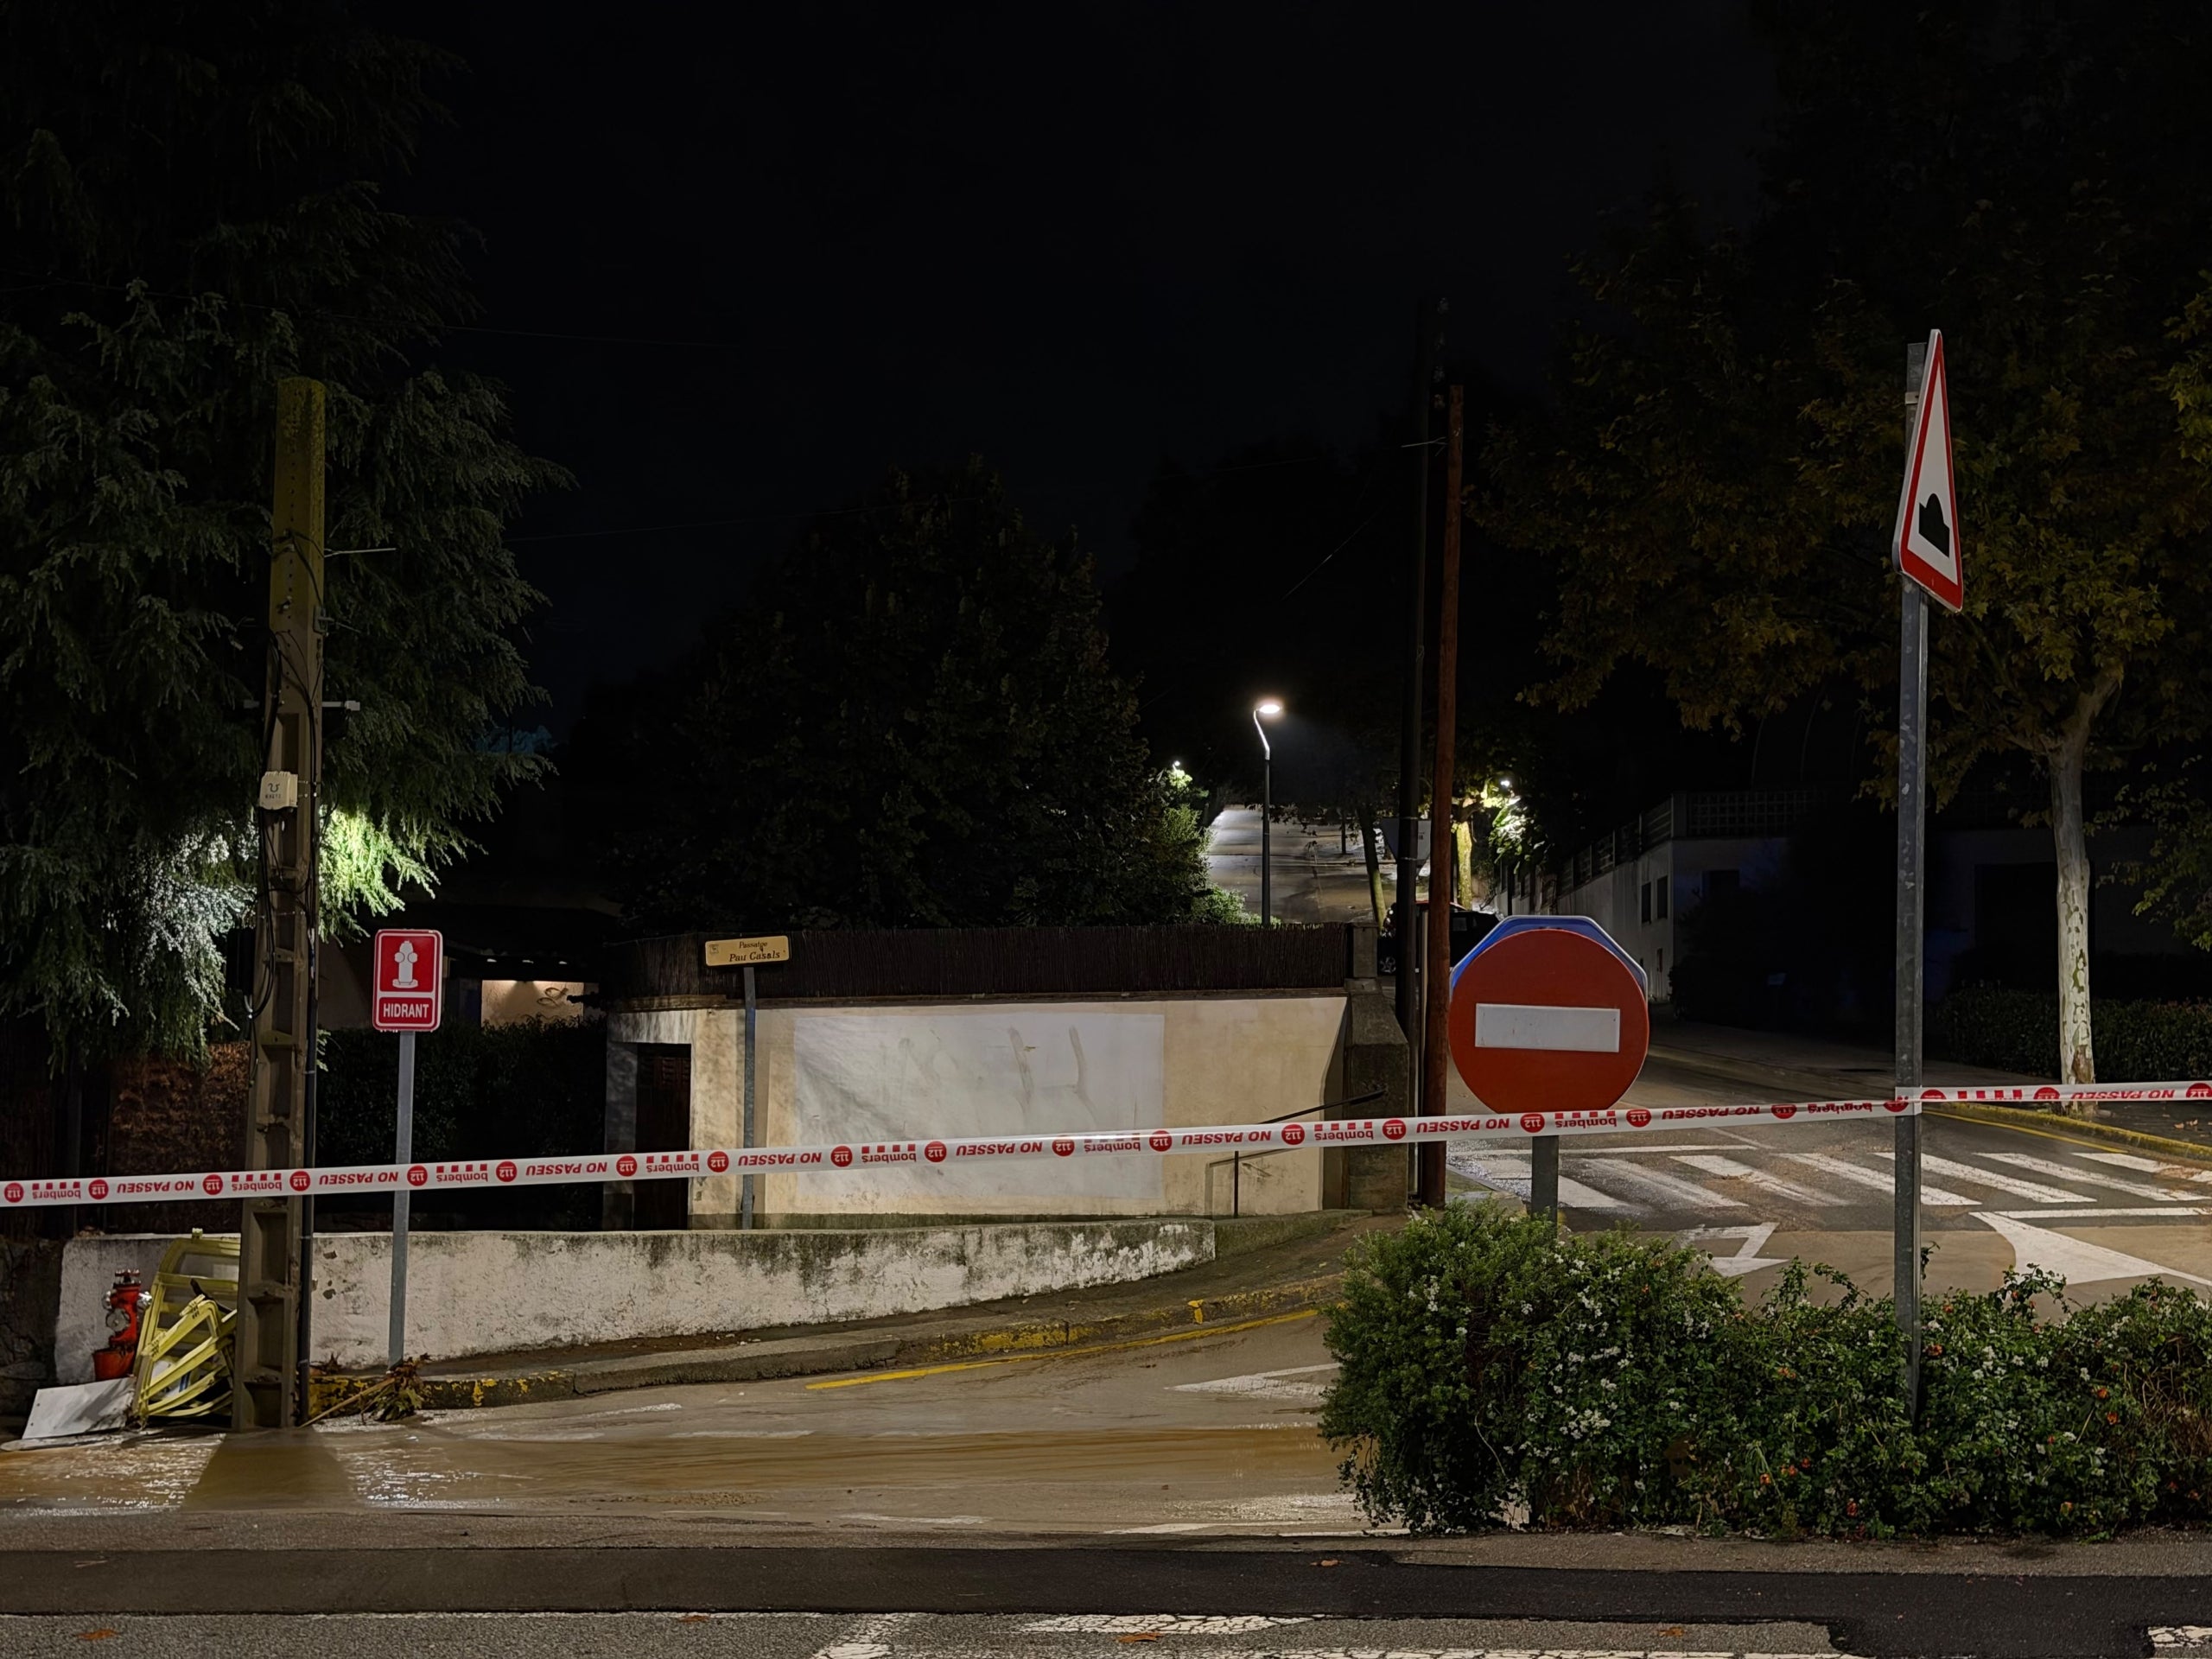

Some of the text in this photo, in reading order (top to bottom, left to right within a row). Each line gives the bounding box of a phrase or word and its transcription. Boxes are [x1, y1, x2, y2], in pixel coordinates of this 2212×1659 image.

[729, 950, 780, 962] Pau Casals
[383, 1003, 429, 1018] HIDRANT
[2148, 1090, 2175, 1098] NO
[1630, 1114, 1648, 1122] 112
[1662, 1106, 1760, 1120] NO PASSEU
[1416, 1119, 1510, 1133] NO PASSEU
[1524, 1119, 1541, 1128] 112
[1554, 1118, 1618, 1128] bombers
[1314, 1130, 1374, 1141] bombers
[1386, 1126, 1403, 1135] 112
[1182, 1131, 1271, 1145] NO PASSEU
[1285, 1131, 1301, 1141] 112
[1055, 1141, 1071, 1151] 112
[1084, 1141, 1141, 1152] bombers
[1152, 1138, 1168, 1147] 112
[928, 1148, 944, 1157] 112
[956, 1142, 1043, 1156] NO PASSEU
[710, 1159, 726, 1167] 112
[738, 1153, 822, 1166] NO PASSEU
[834, 1154, 849, 1162] 112
[861, 1153, 917, 1163] bombers
[526, 1162, 607, 1175] NO PASSEU
[620, 1163, 634, 1172] 112
[646, 1163, 700, 1173] bombers
[293, 1178, 308, 1186] 112
[319, 1172, 398, 1185] NO PASSEU
[436, 1172, 488, 1183] bombers
[92, 1186, 105, 1195] 112
[118, 1181, 194, 1193] NO PASSEU
[232, 1182, 283, 1192] bombers
[32, 1189, 81, 1199] bombers
